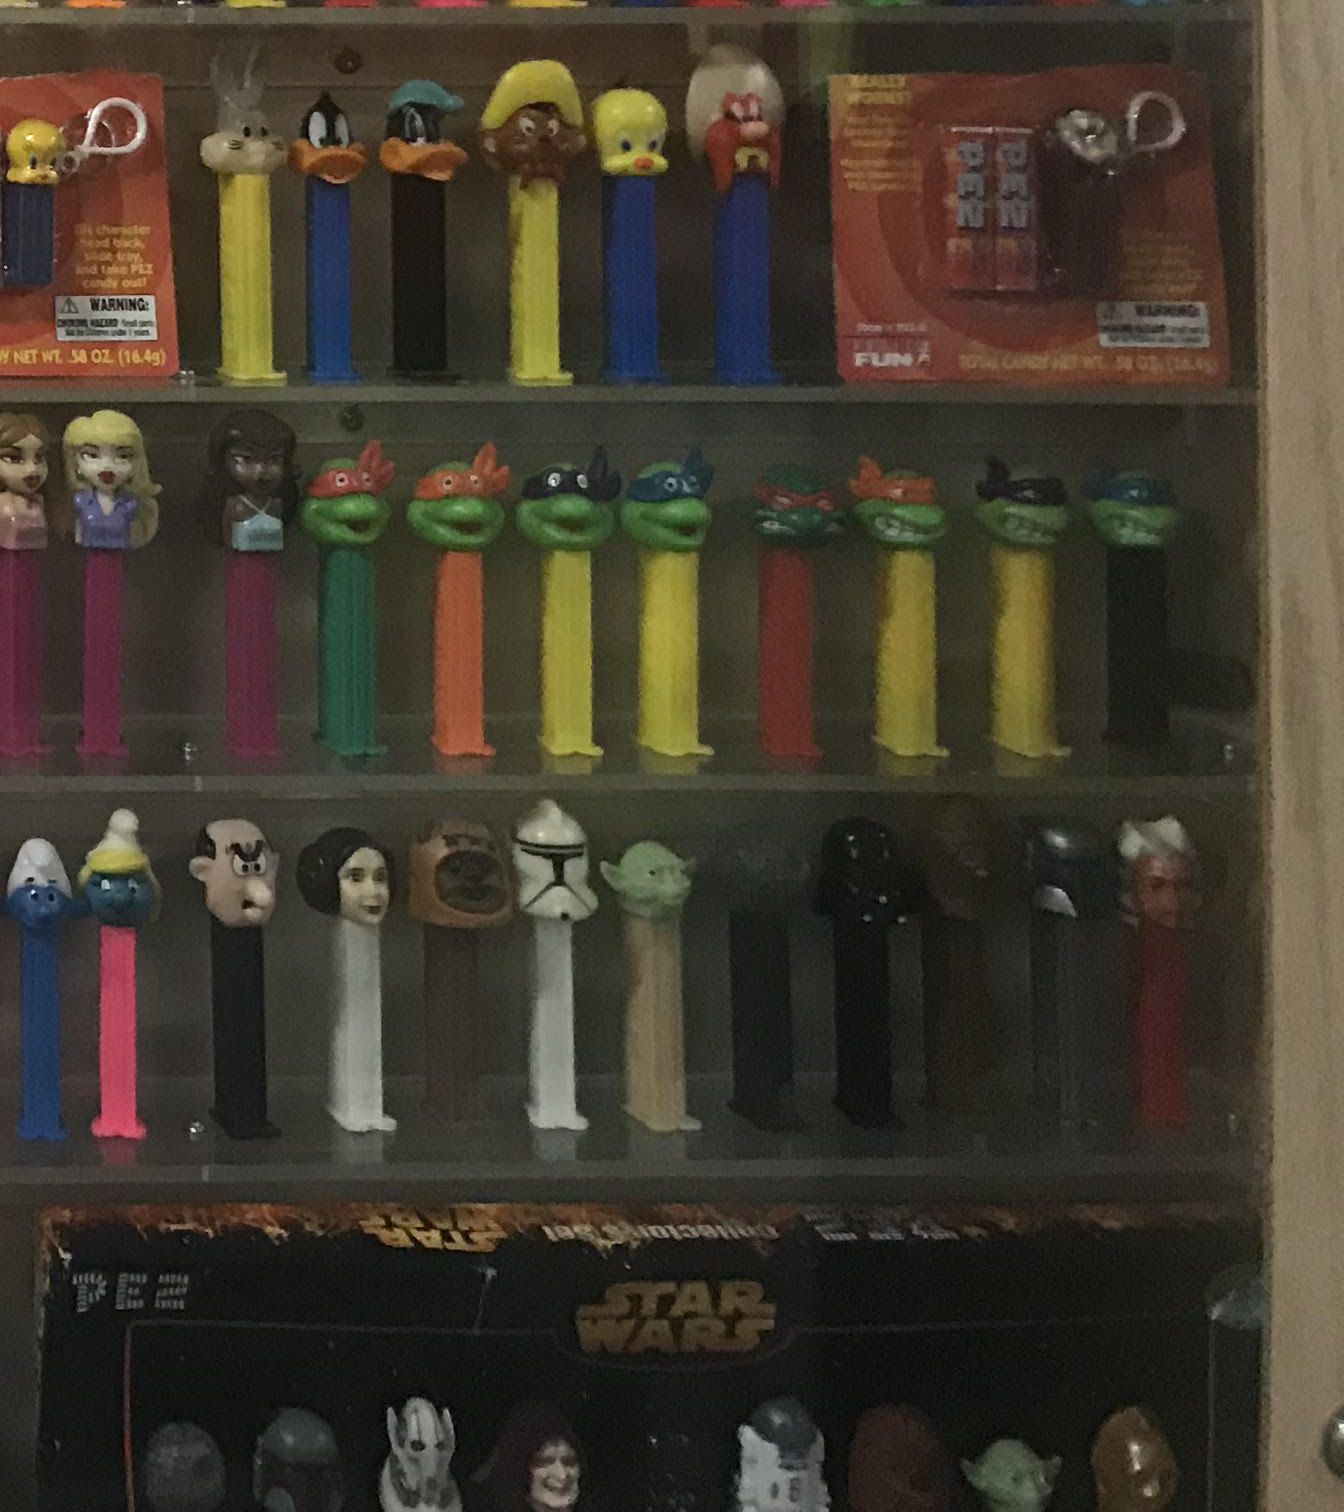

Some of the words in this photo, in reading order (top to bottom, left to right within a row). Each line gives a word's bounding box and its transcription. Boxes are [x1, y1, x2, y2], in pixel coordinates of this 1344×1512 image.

[130, 263, 154, 275] PEZ
[89, 297, 150, 312] WARNING:
[13, 349, 39, 364] NET
[854, 352, 912, 367] FUN
[71, 1272, 190, 1313] PEZ
[575, 1279, 777, 1319] STAR
[575, 1317, 776, 1354] WARS
